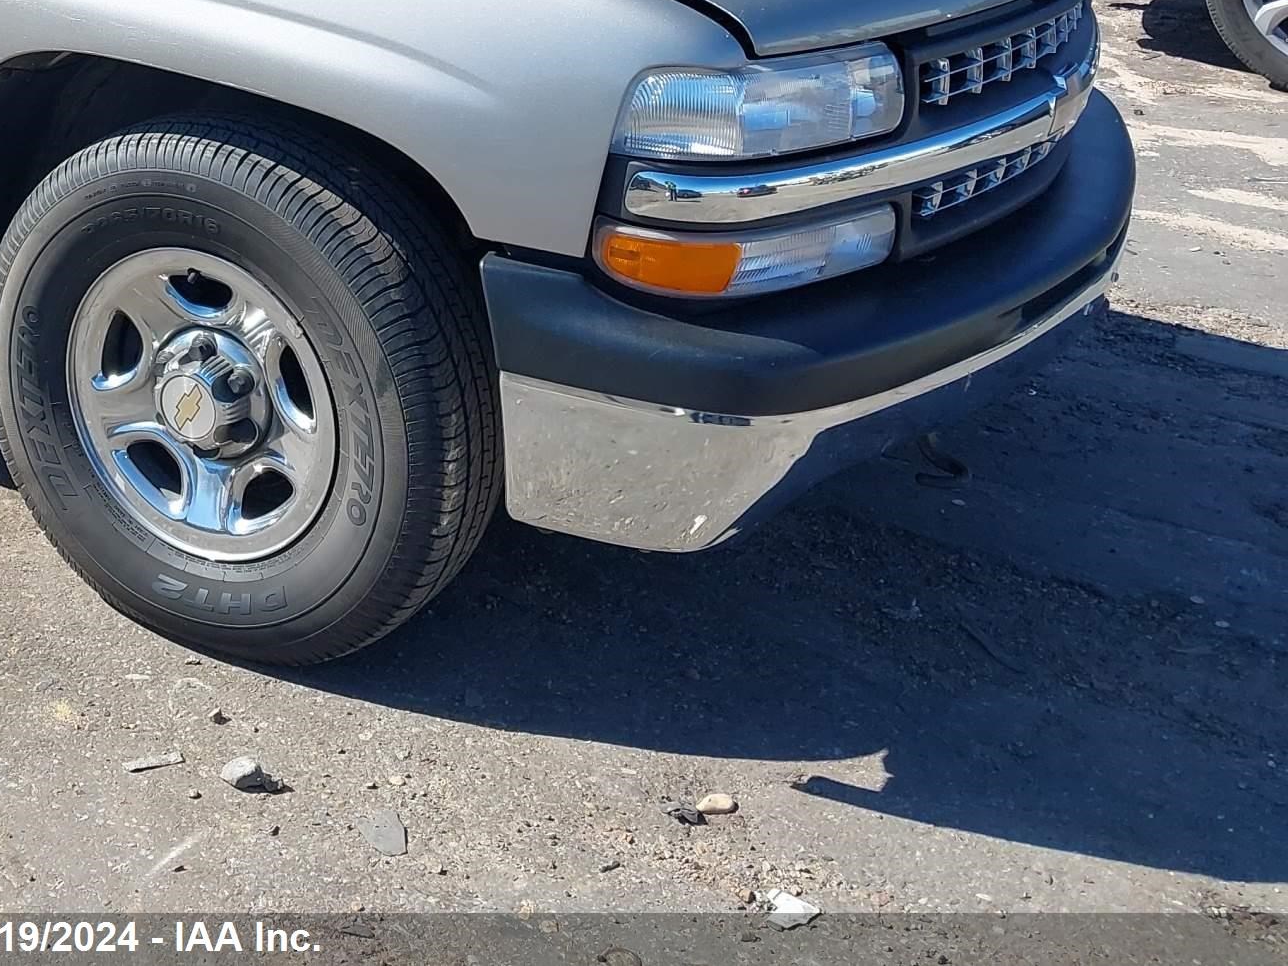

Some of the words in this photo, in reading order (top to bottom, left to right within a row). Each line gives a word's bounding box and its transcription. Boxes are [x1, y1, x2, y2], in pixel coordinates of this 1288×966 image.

[15, 305, 80, 511] DEXTERO
[310, 294, 375, 528] DEXTERO
[151, 572, 289, 615] DHT2
